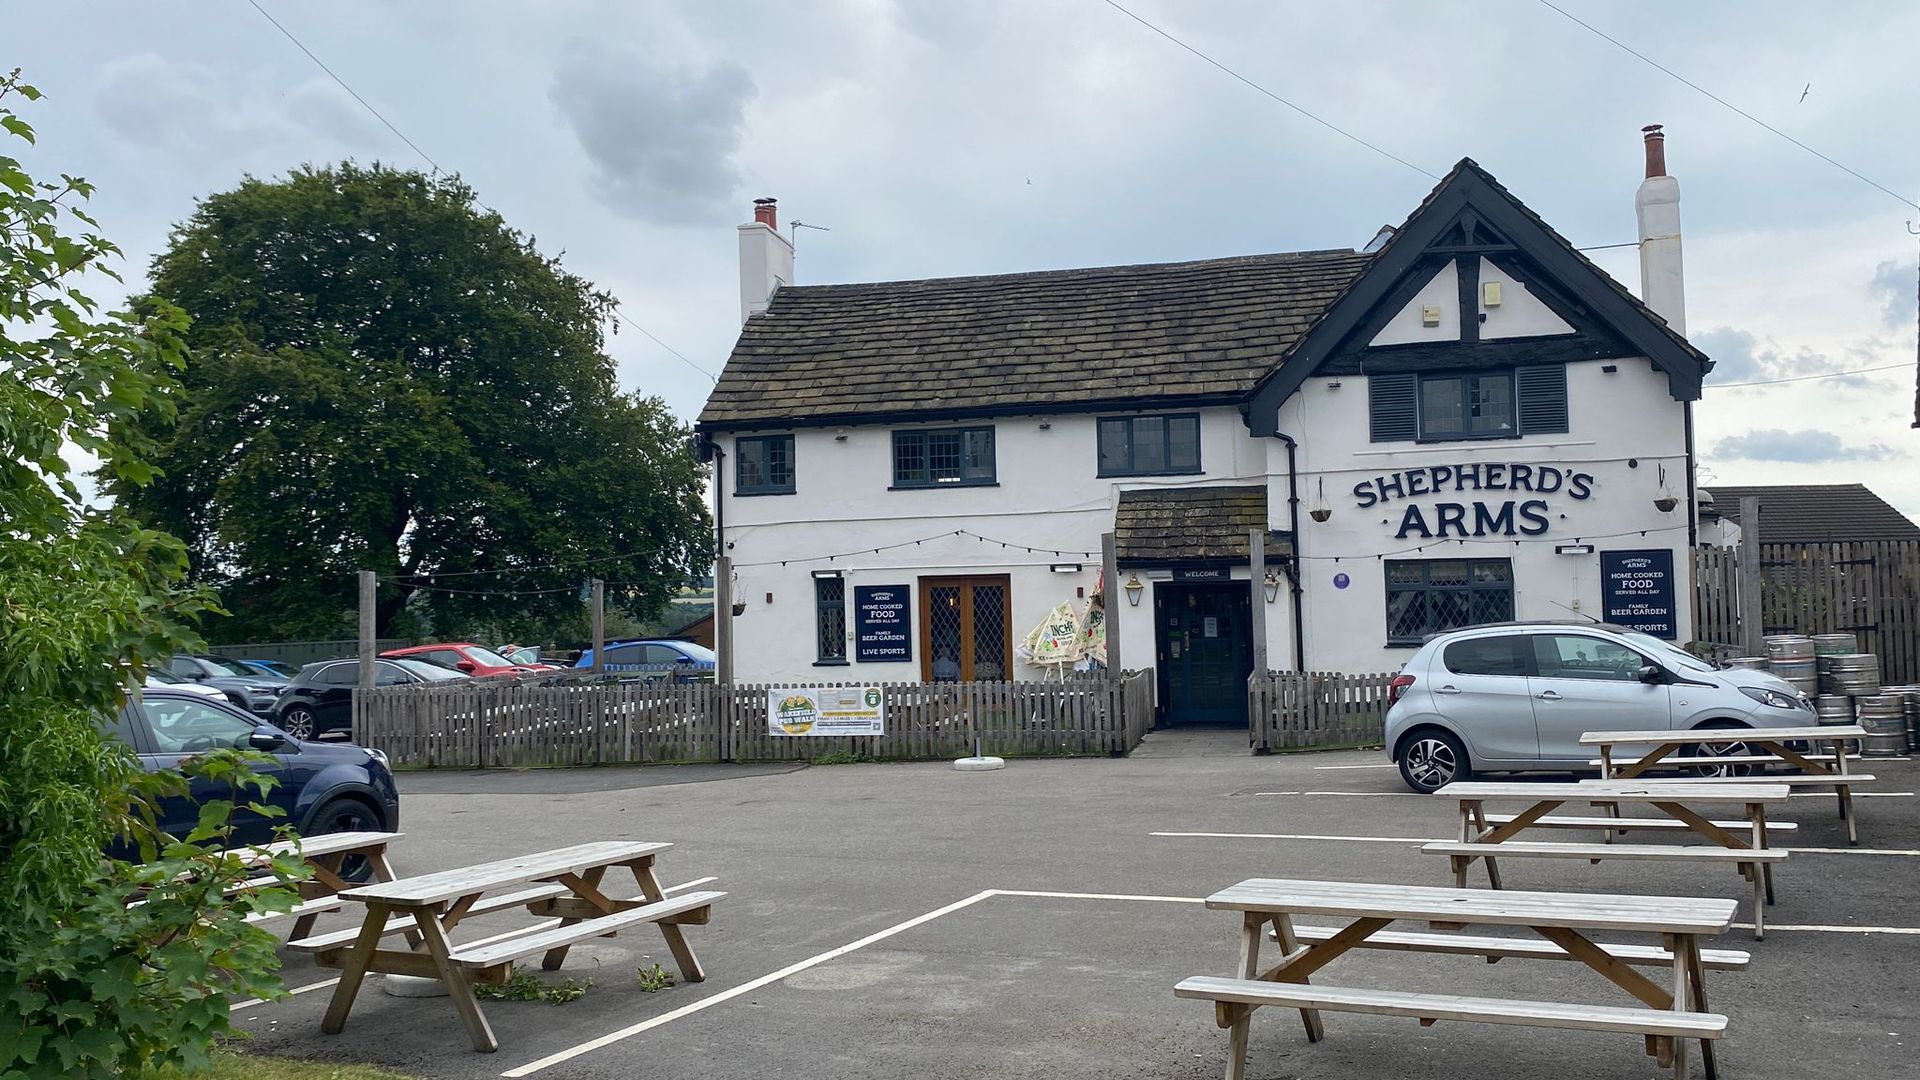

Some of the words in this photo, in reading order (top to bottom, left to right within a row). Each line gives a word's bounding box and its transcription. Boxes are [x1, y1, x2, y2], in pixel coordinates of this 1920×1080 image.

[1353, 463, 1594, 508] SHEPHERD'S
[1394, 500, 1550, 539] ARMS
[1622, 580, 1654, 588] FOOD
